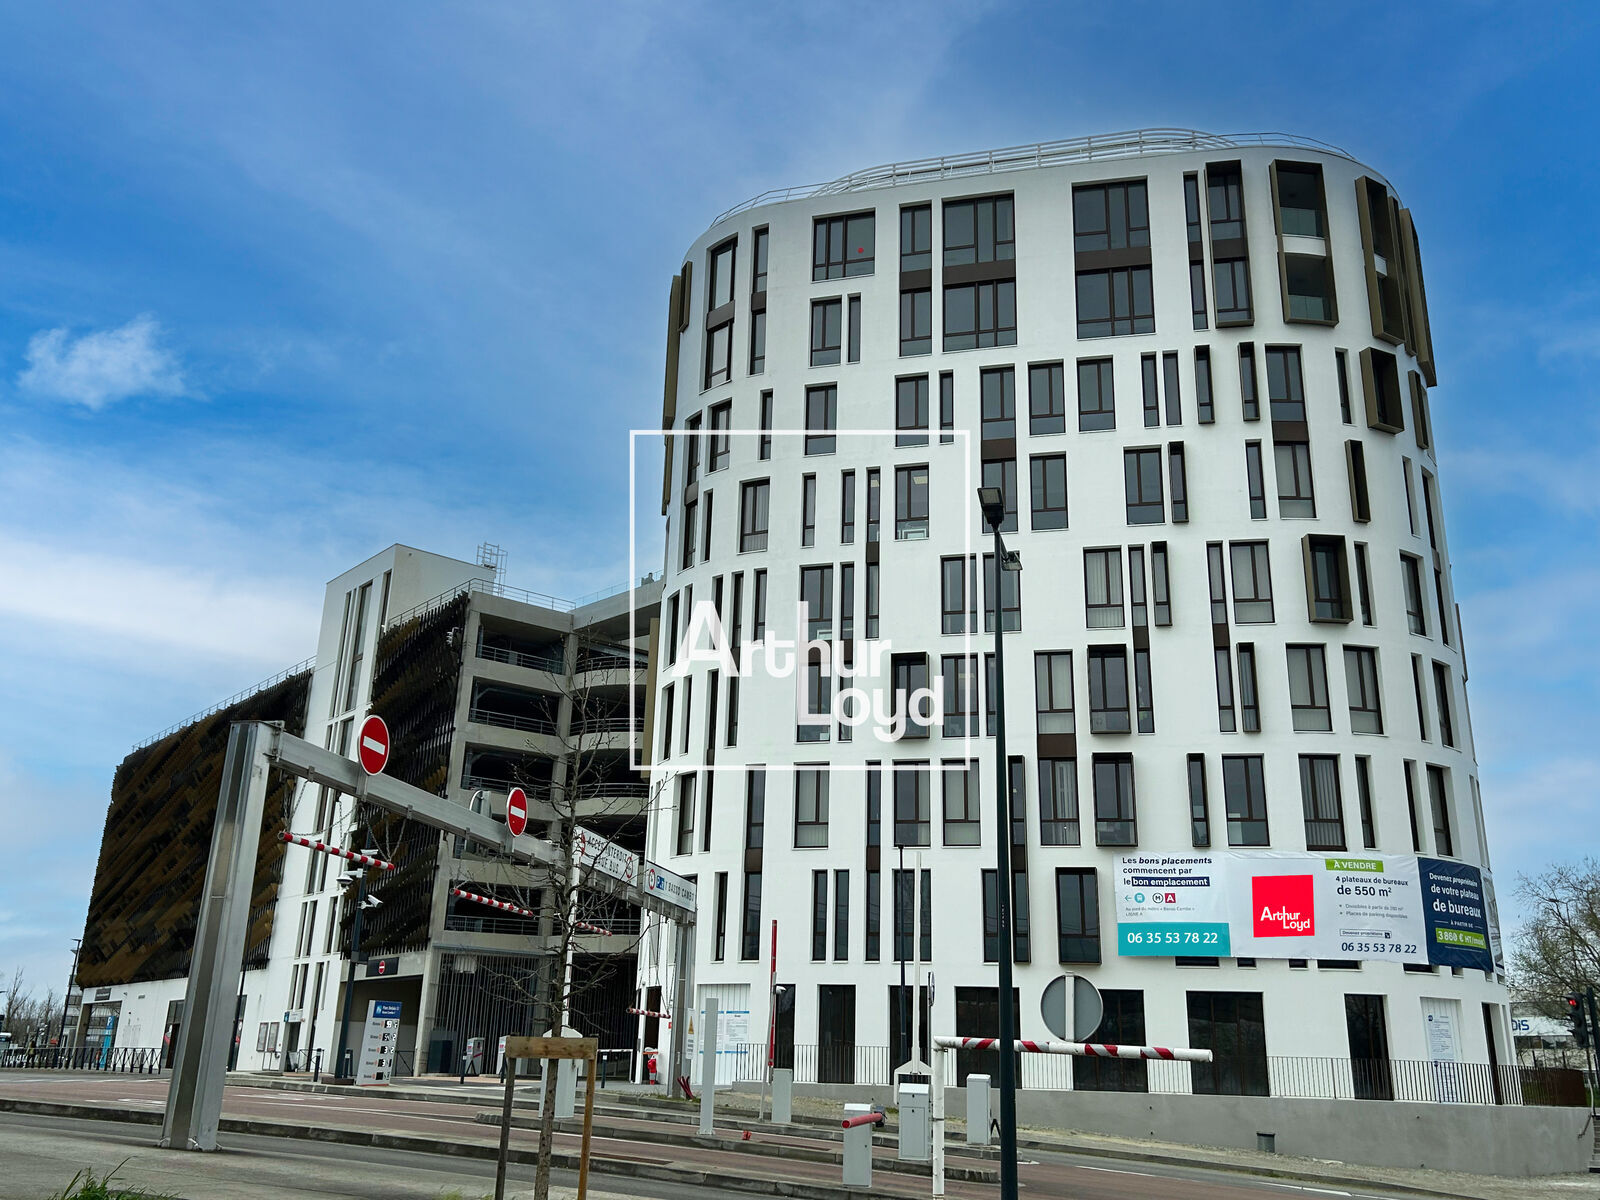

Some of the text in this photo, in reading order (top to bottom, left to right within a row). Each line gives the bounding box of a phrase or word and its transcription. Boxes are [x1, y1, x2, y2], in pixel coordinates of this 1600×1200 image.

[1138, 857, 1160, 865] bons
[1161, 857, 1213, 866] placements
[1341, 861, 1377, 870] VENDRE
[1122, 867, 1177, 875] commencent
[1132, 878, 1149, 886] bon
[1150, 878, 1208, 887] emplacement
[1341, 876, 1372, 884] plateaux
[1383, 878, 1409, 886] bureaux
[1429, 872, 1452, 882] Devenez
[1337, 885, 1351, 895] de
[1354, 886, 1375, 896] 550
[1430, 884, 1480, 900] de votre plateau
[1260, 906, 1300, 921] Arthur
[1433, 899, 1482, 918] de bureaux
[1283, 918, 1310, 931] Loyd
[1127, 932, 1218, 944] 06 35 53 78 22
[1341, 942, 1417, 953] 06 35 53 78 22
